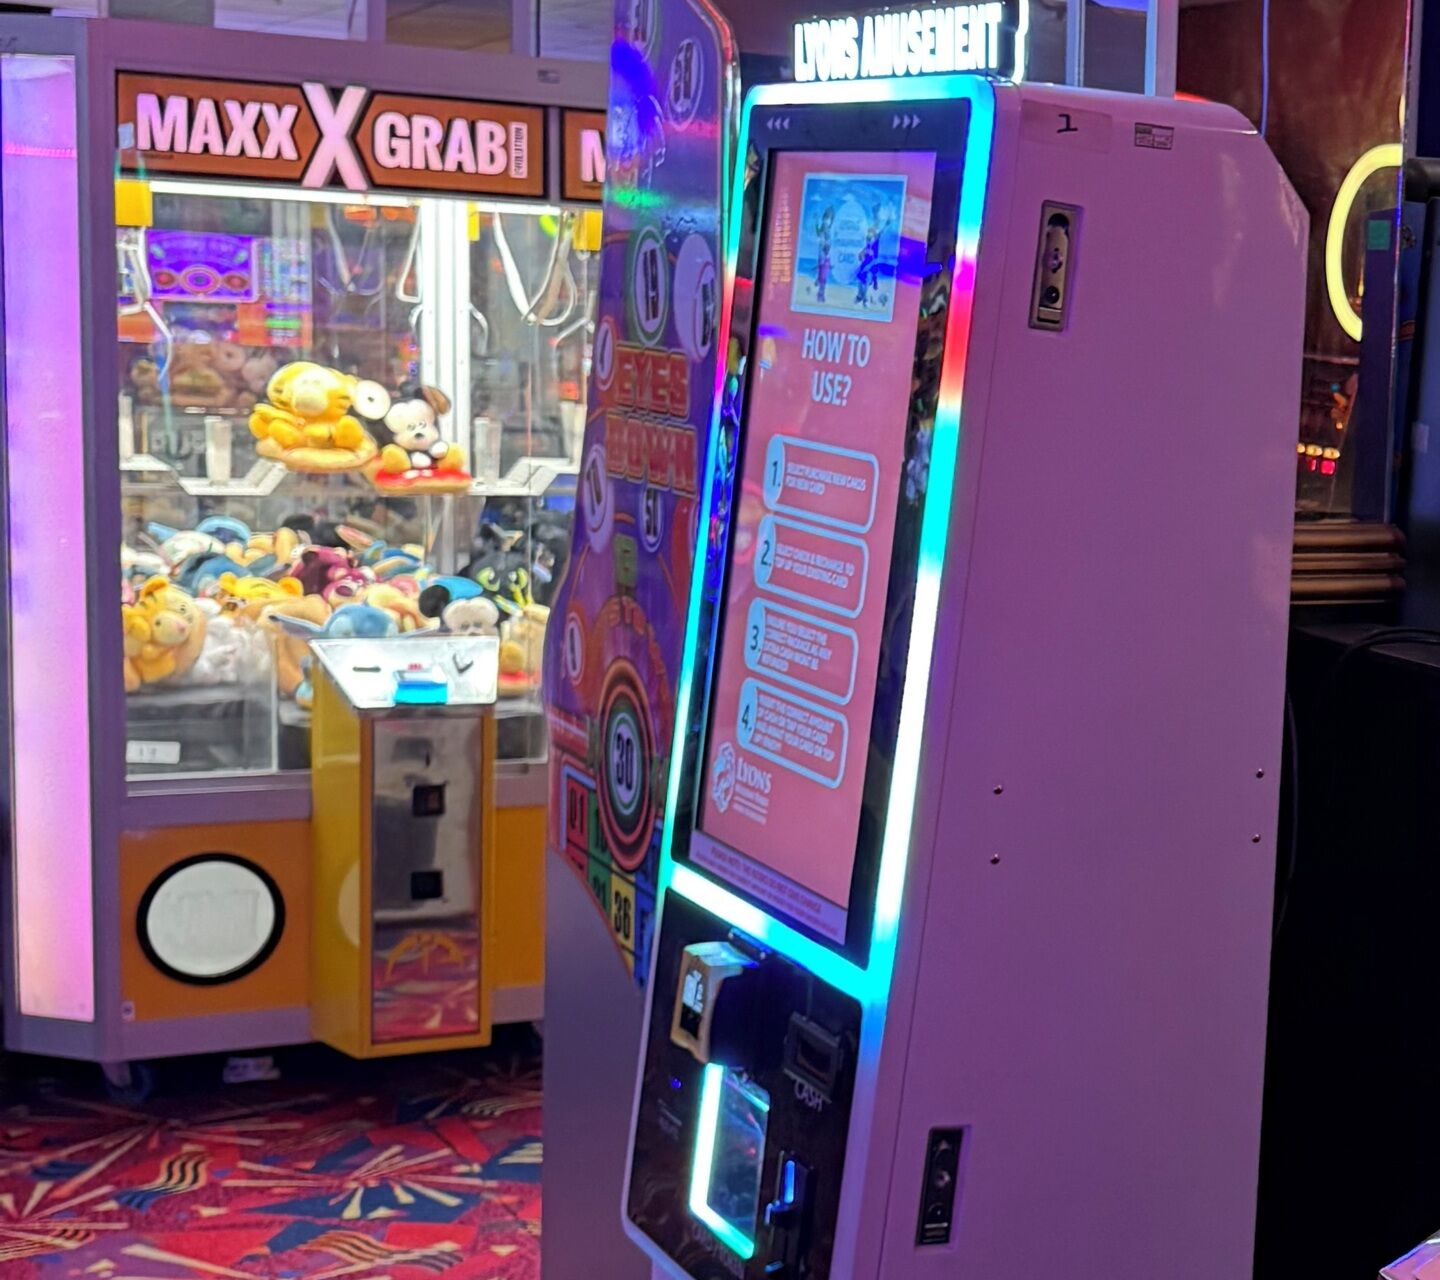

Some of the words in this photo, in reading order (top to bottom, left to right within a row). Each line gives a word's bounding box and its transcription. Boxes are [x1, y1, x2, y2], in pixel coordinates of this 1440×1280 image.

[794, 16, 859, 82] LYONS
[860, 1, 1002, 78] AMUSEMENT
[136, 93, 299, 161] MAXX
[301, 82, 369, 191] X
[373, 111, 507, 176] GRAB
[801, 328, 847, 365] HOW
[847, 334, 871, 368] TO
[615, 344, 689, 419] EYES
[811, 370, 852, 408] USE?
[604, 412, 698, 497] DOWN
[615, 732, 633, 792] 30
[736, 756, 773, 794] LYONS
[614, 889, 631, 941] 36
